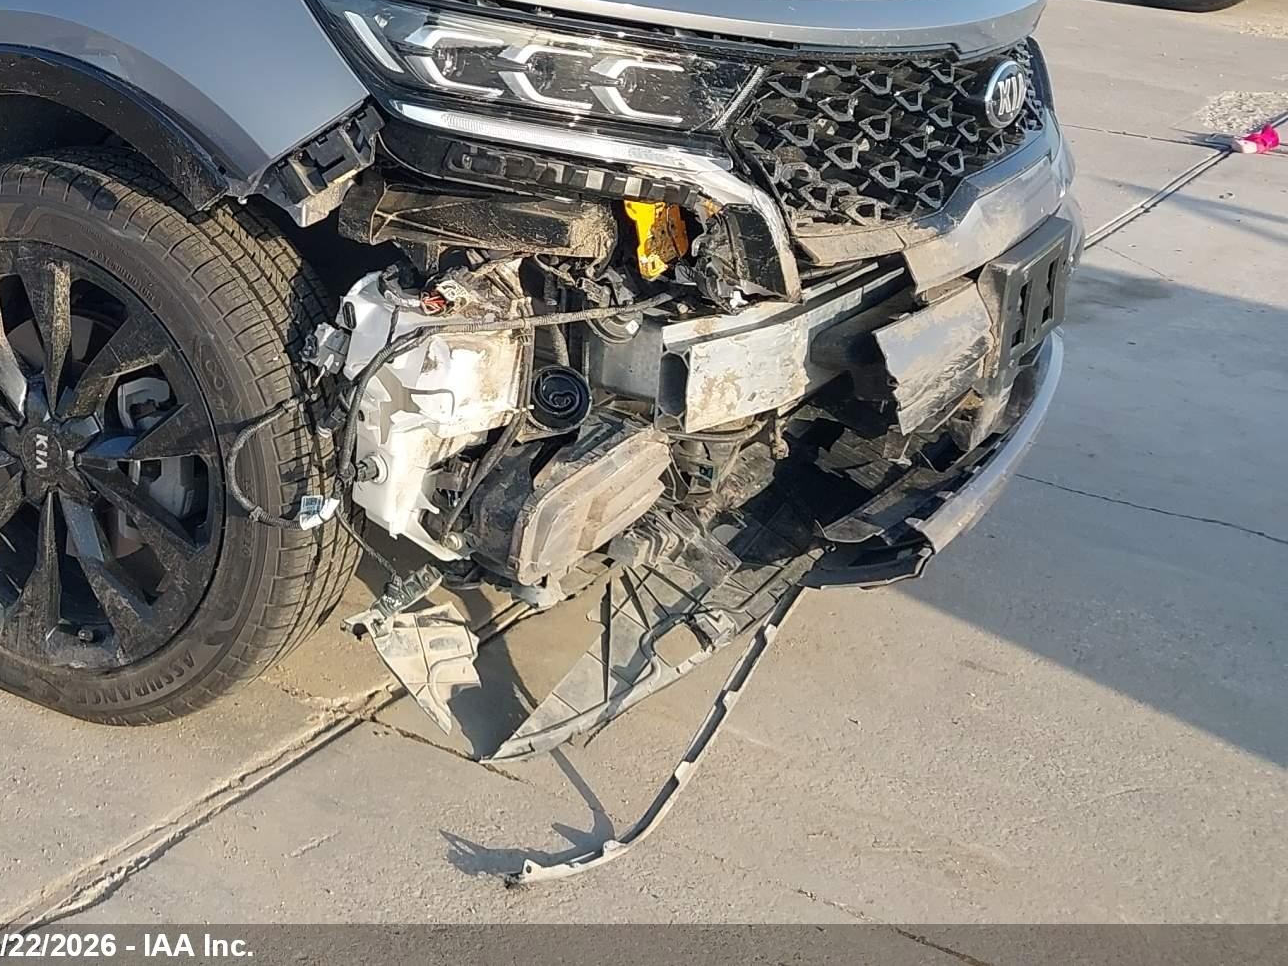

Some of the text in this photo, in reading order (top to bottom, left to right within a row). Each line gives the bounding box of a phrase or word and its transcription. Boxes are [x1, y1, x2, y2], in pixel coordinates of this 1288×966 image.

[997, 72, 1026, 116] KIA
[35, 433, 50, 470] KIA
[76, 648, 196, 706] ASSURANCE
